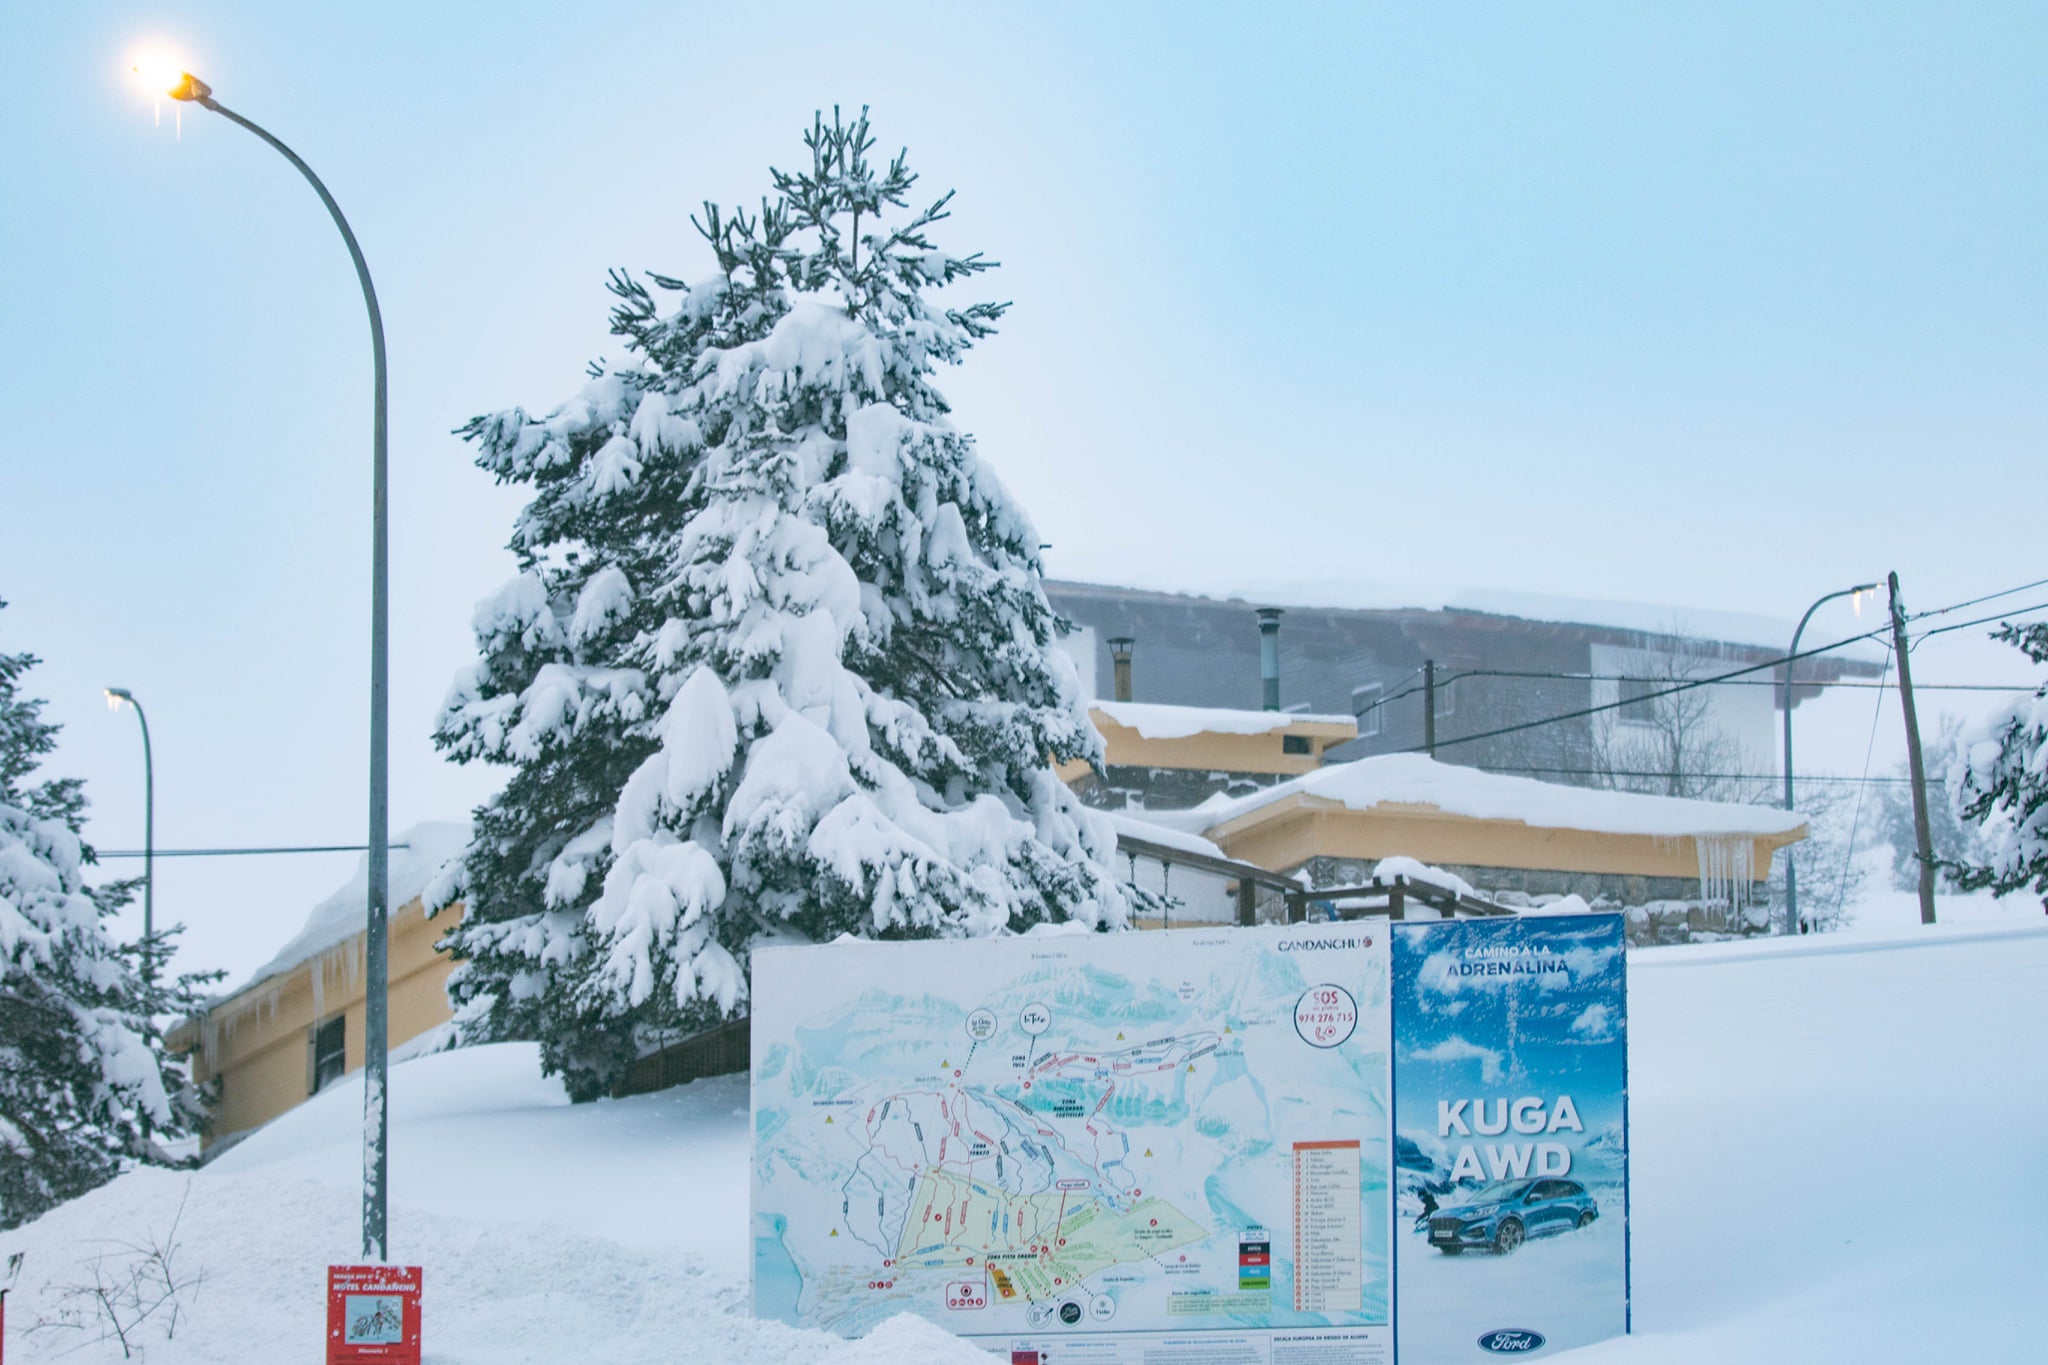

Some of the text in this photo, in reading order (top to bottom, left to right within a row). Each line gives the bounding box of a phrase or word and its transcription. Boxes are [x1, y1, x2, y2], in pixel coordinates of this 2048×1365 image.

[1464, 945, 1551, 958] CAMINO A LA
[1446, 959, 1570, 977] ADRENALINA
[1313, 991, 1338, 1004] SOS
[1299, 1014, 1314, 1023] 974
[1318, 1013, 1334, 1023] 276
[1438, 1095, 1584, 1136] KUGA
[1449, 1142, 1571, 1182] AWD
[333, 1283, 360, 1291] HOTEL
[1491, 1332, 1532, 1350] Ford
